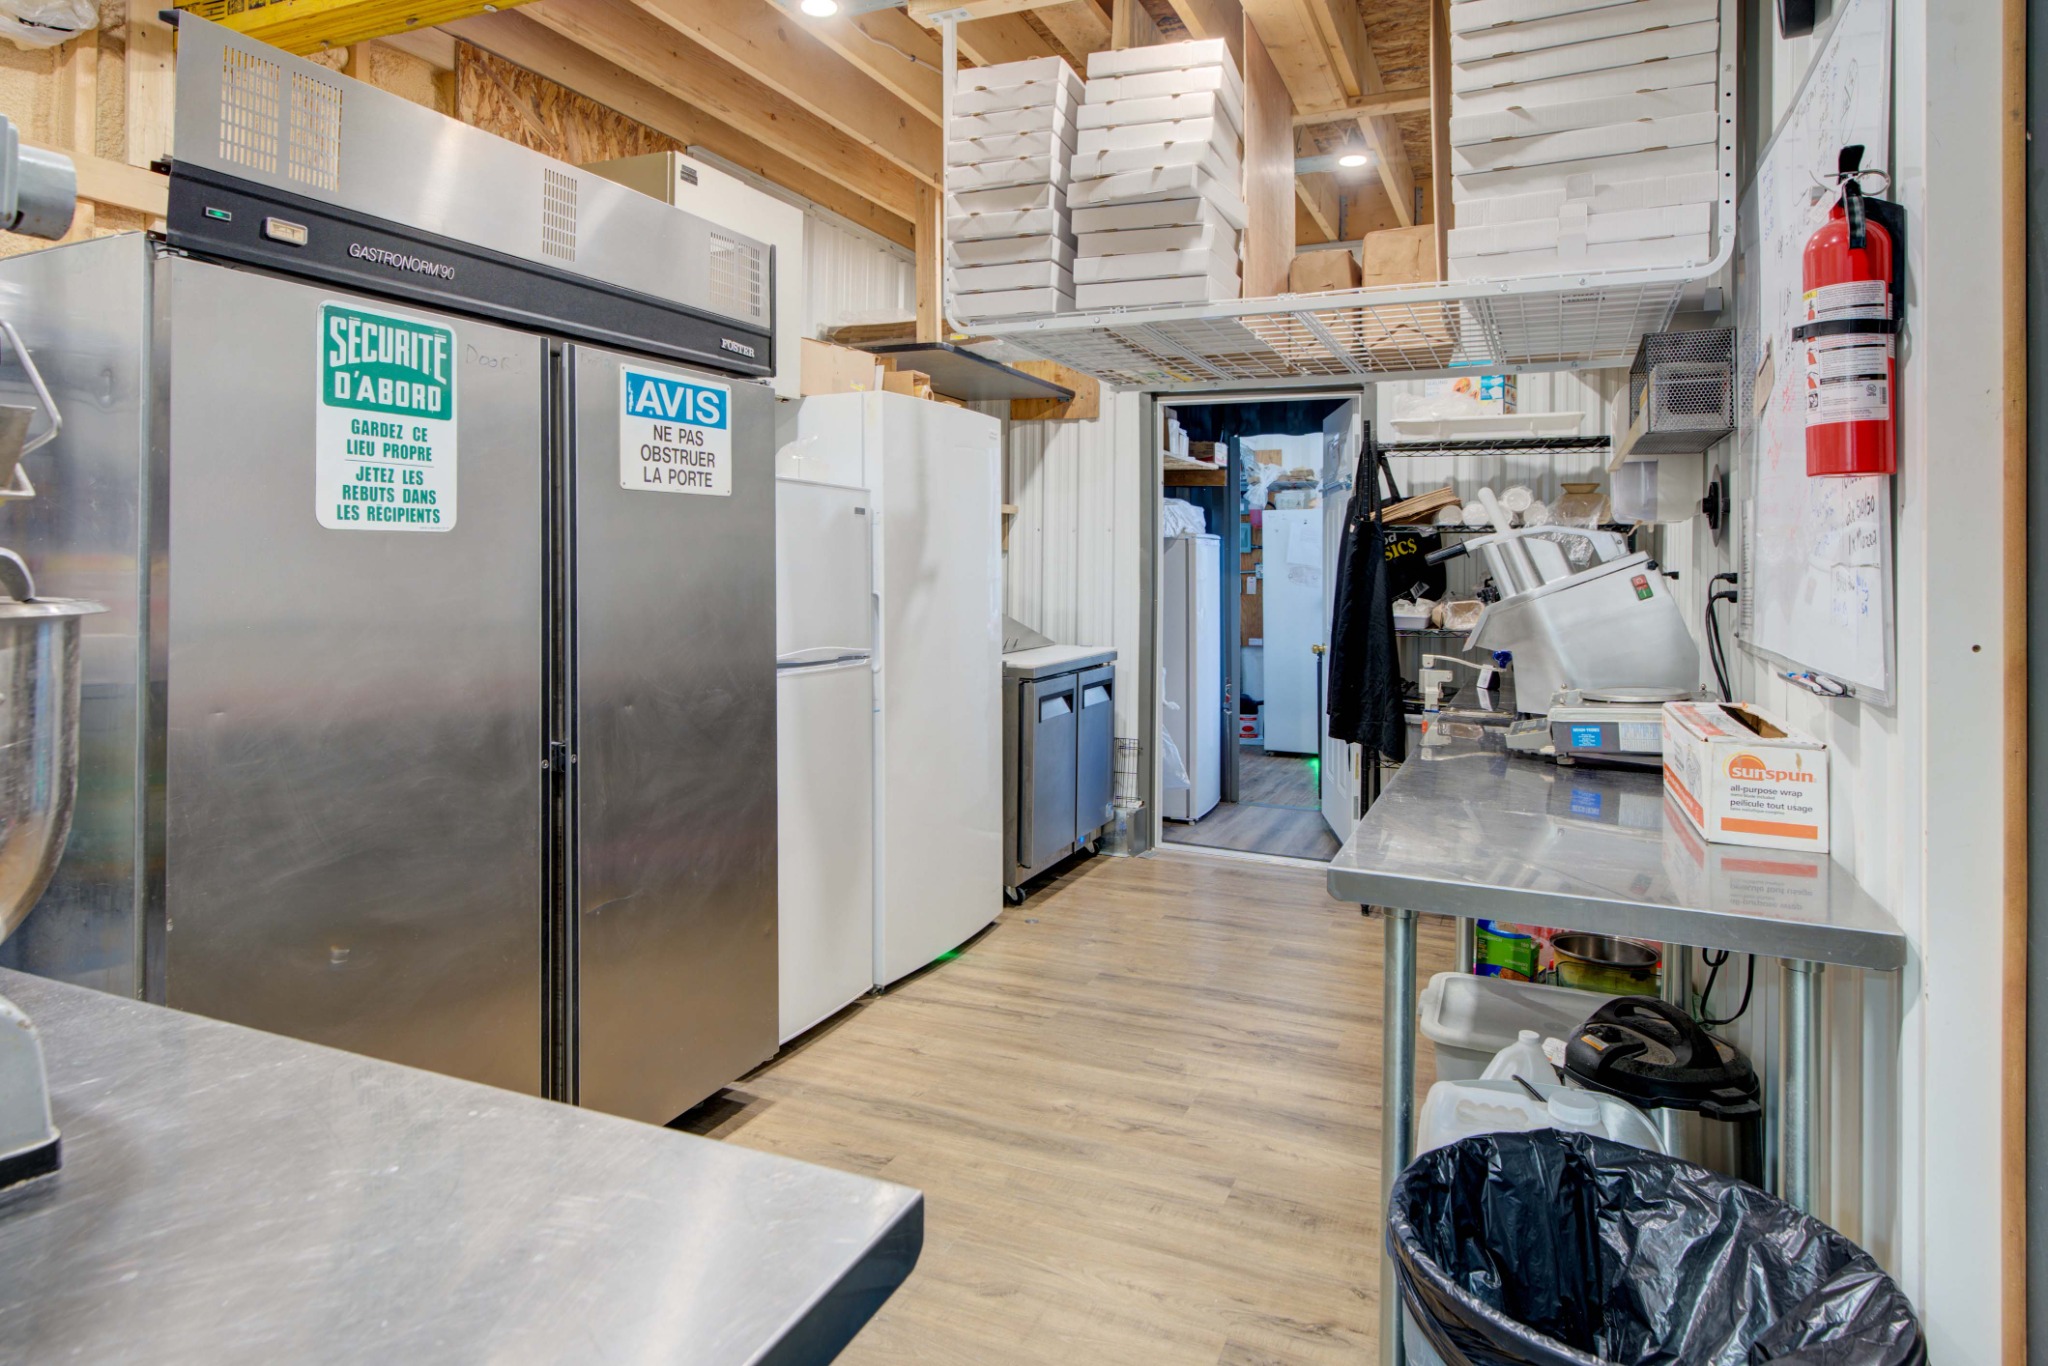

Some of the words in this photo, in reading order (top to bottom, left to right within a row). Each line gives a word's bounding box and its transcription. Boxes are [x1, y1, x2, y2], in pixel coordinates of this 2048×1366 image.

[349, 243, 455, 280] GASTRONORM'90
[329, 316, 447, 385] SÉCURITÉ
[720, 338, 755, 358] FOSTER
[335, 371, 442, 412] D'ABORD
[635, 380, 720, 424] AVIS
[351, 418, 403, 439] GARDEZ
[413, 427, 428, 442] CE
[653, 424, 672, 442] NE
[679, 428, 704, 446] PAS
[346, 439, 375, 456] LIEU
[383, 442, 432, 462] PROPRE
[641, 444, 715, 468] OBSTRUER
[356, 466, 394, 483] JETEZ
[402, 470, 424, 485] LES
[643, 466, 662, 483] LA
[668, 469, 713, 487] PORTE
[342, 485, 394, 502] REBUTS
[403, 488, 436, 505] DANS
[337, 504, 360, 521] LES
[367, 504, 440, 524] RÉCIPIENTS
[1731, 766, 1814, 783] sunspun
[1730, 785, 1778, 795] all-purpose
[1780, 790, 1803, 798] wrap
[1767, 802, 1785, 810] tout
[1787, 805, 1813, 813] usage
